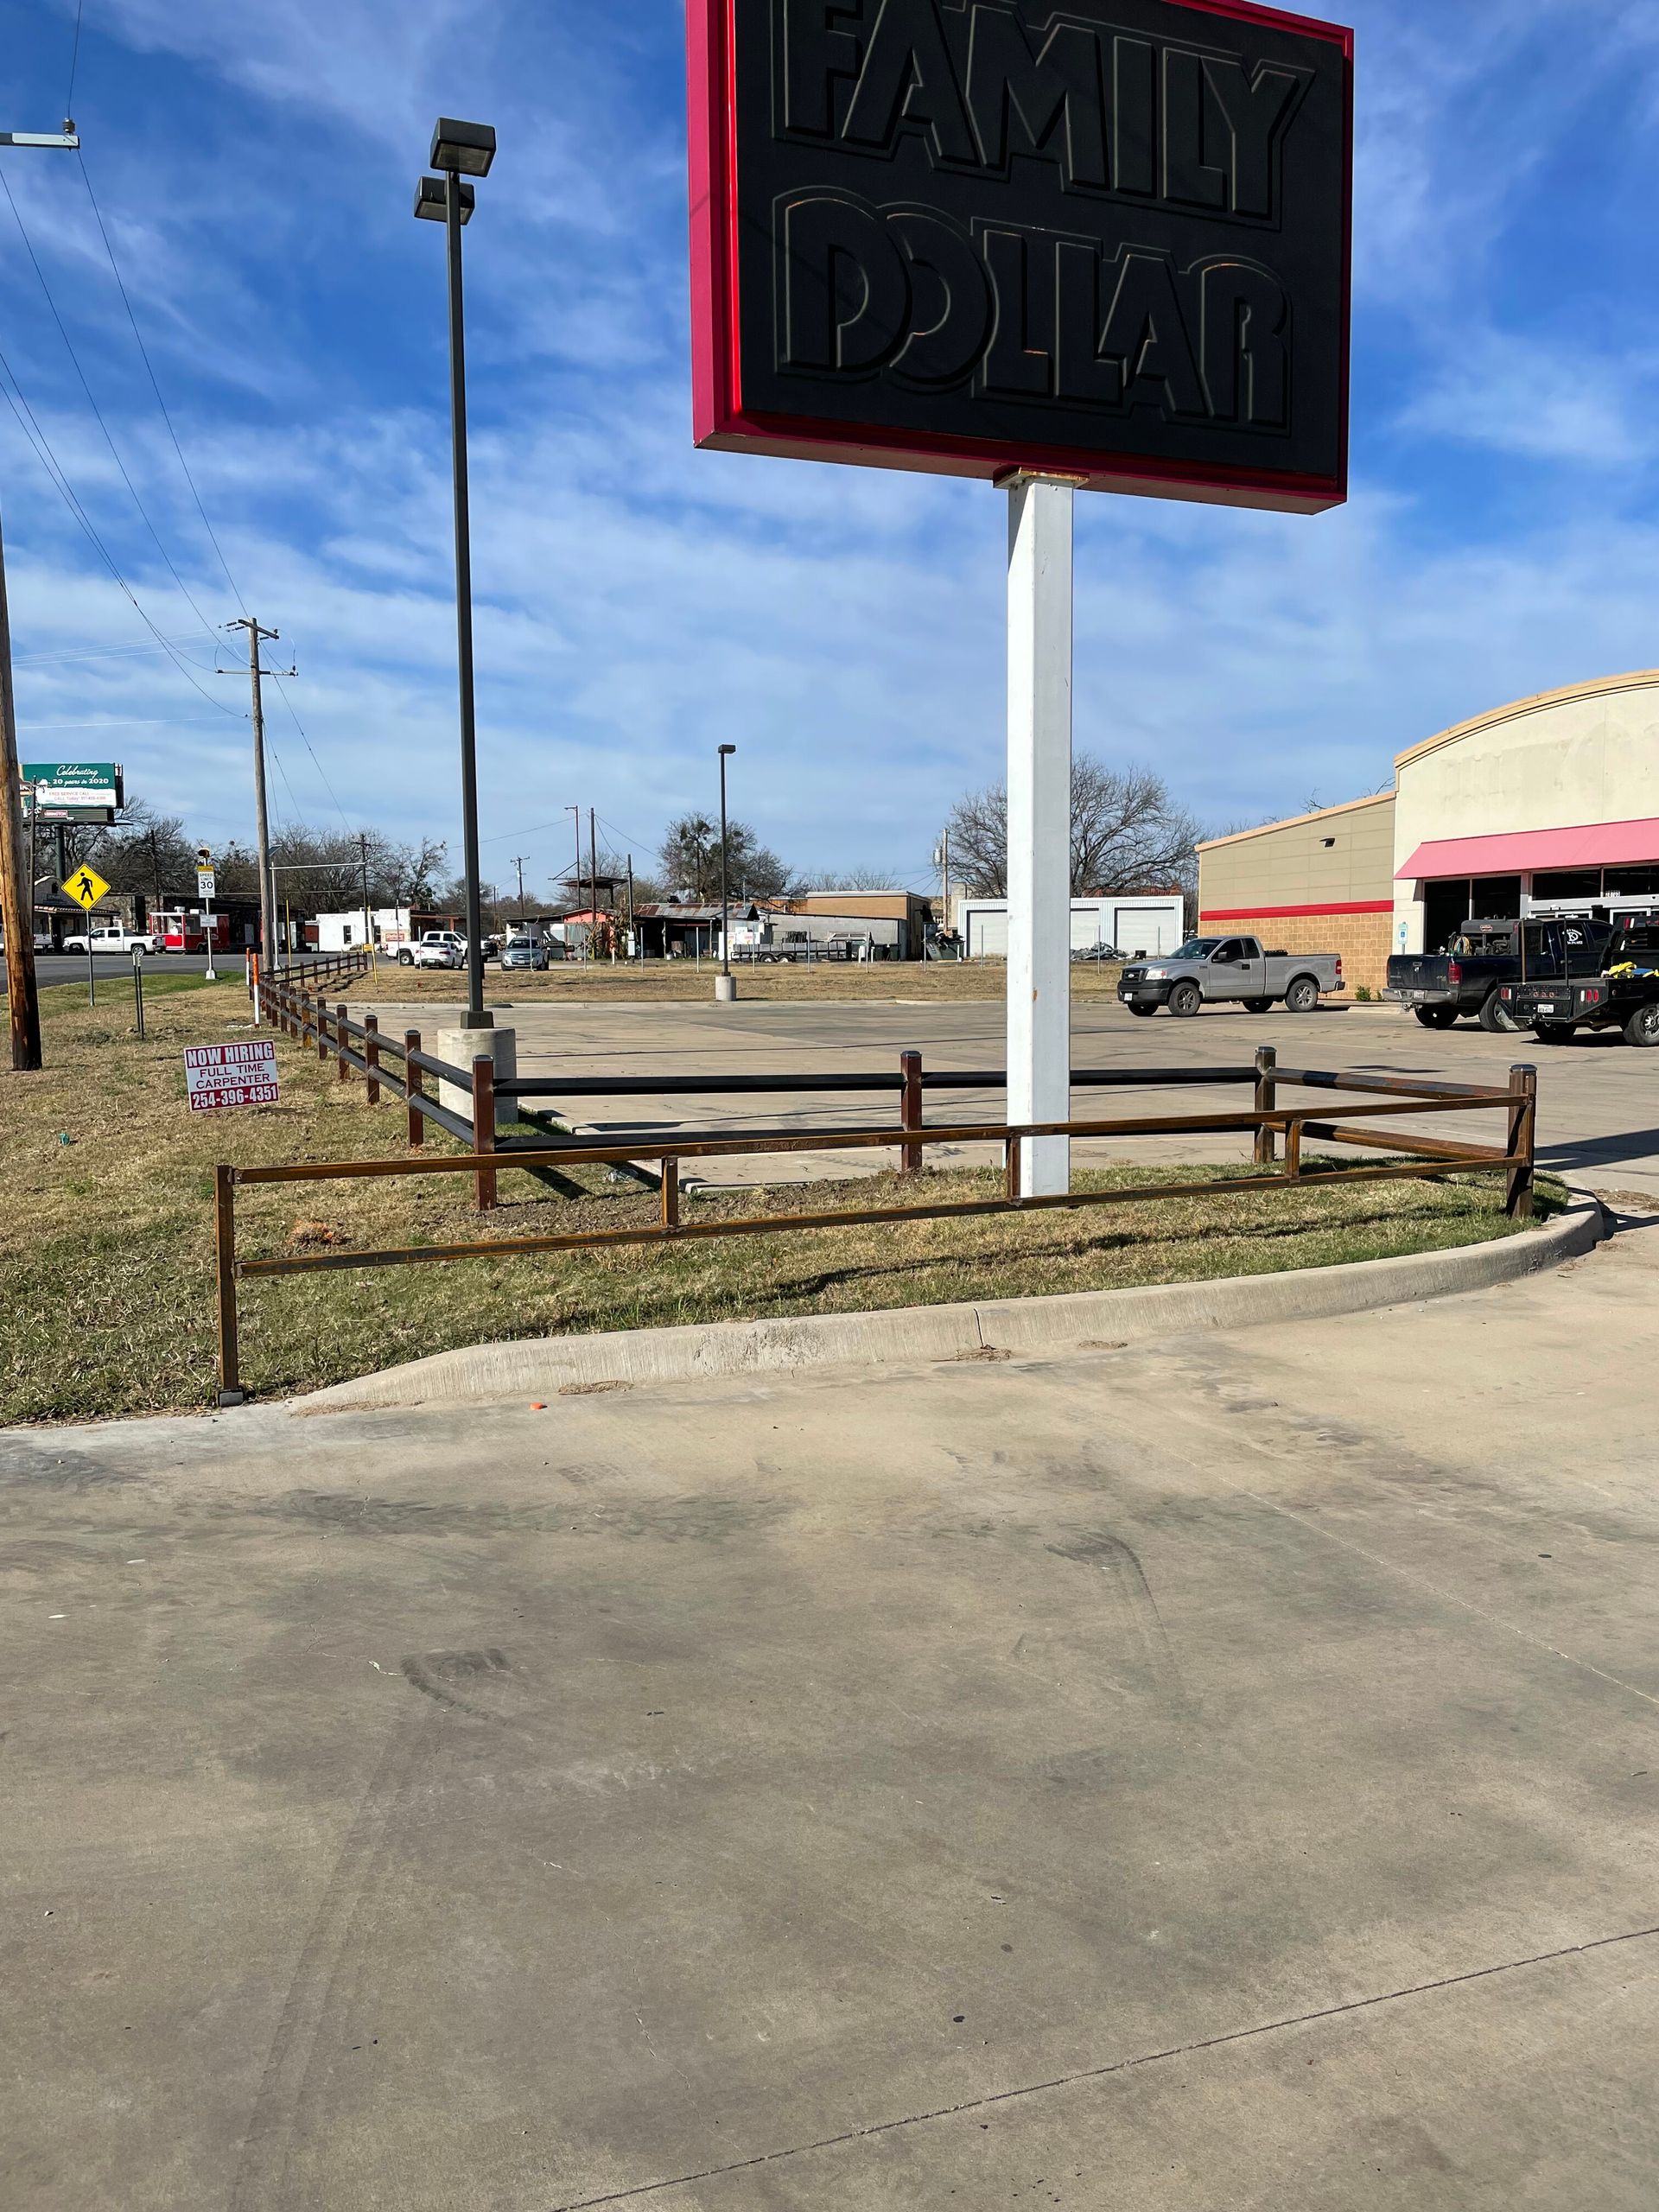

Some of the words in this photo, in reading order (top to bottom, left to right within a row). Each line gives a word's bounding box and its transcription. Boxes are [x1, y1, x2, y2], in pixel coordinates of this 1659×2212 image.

[775, 0, 1312, 226] FAMILY
[777, 189, 1292, 435] DOLLAR
[56, 765, 99, 779] Celebrating
[187, 1047, 222, 1068] NOW
[224, 1042, 274, 1064] HIRING
[195, 1073, 270, 1090] CARPENTER
[200, 1066, 232, 1078] FULL
[236, 1062, 265, 1074] TIME
[192, 1084, 277, 1109] 254-396-4351
